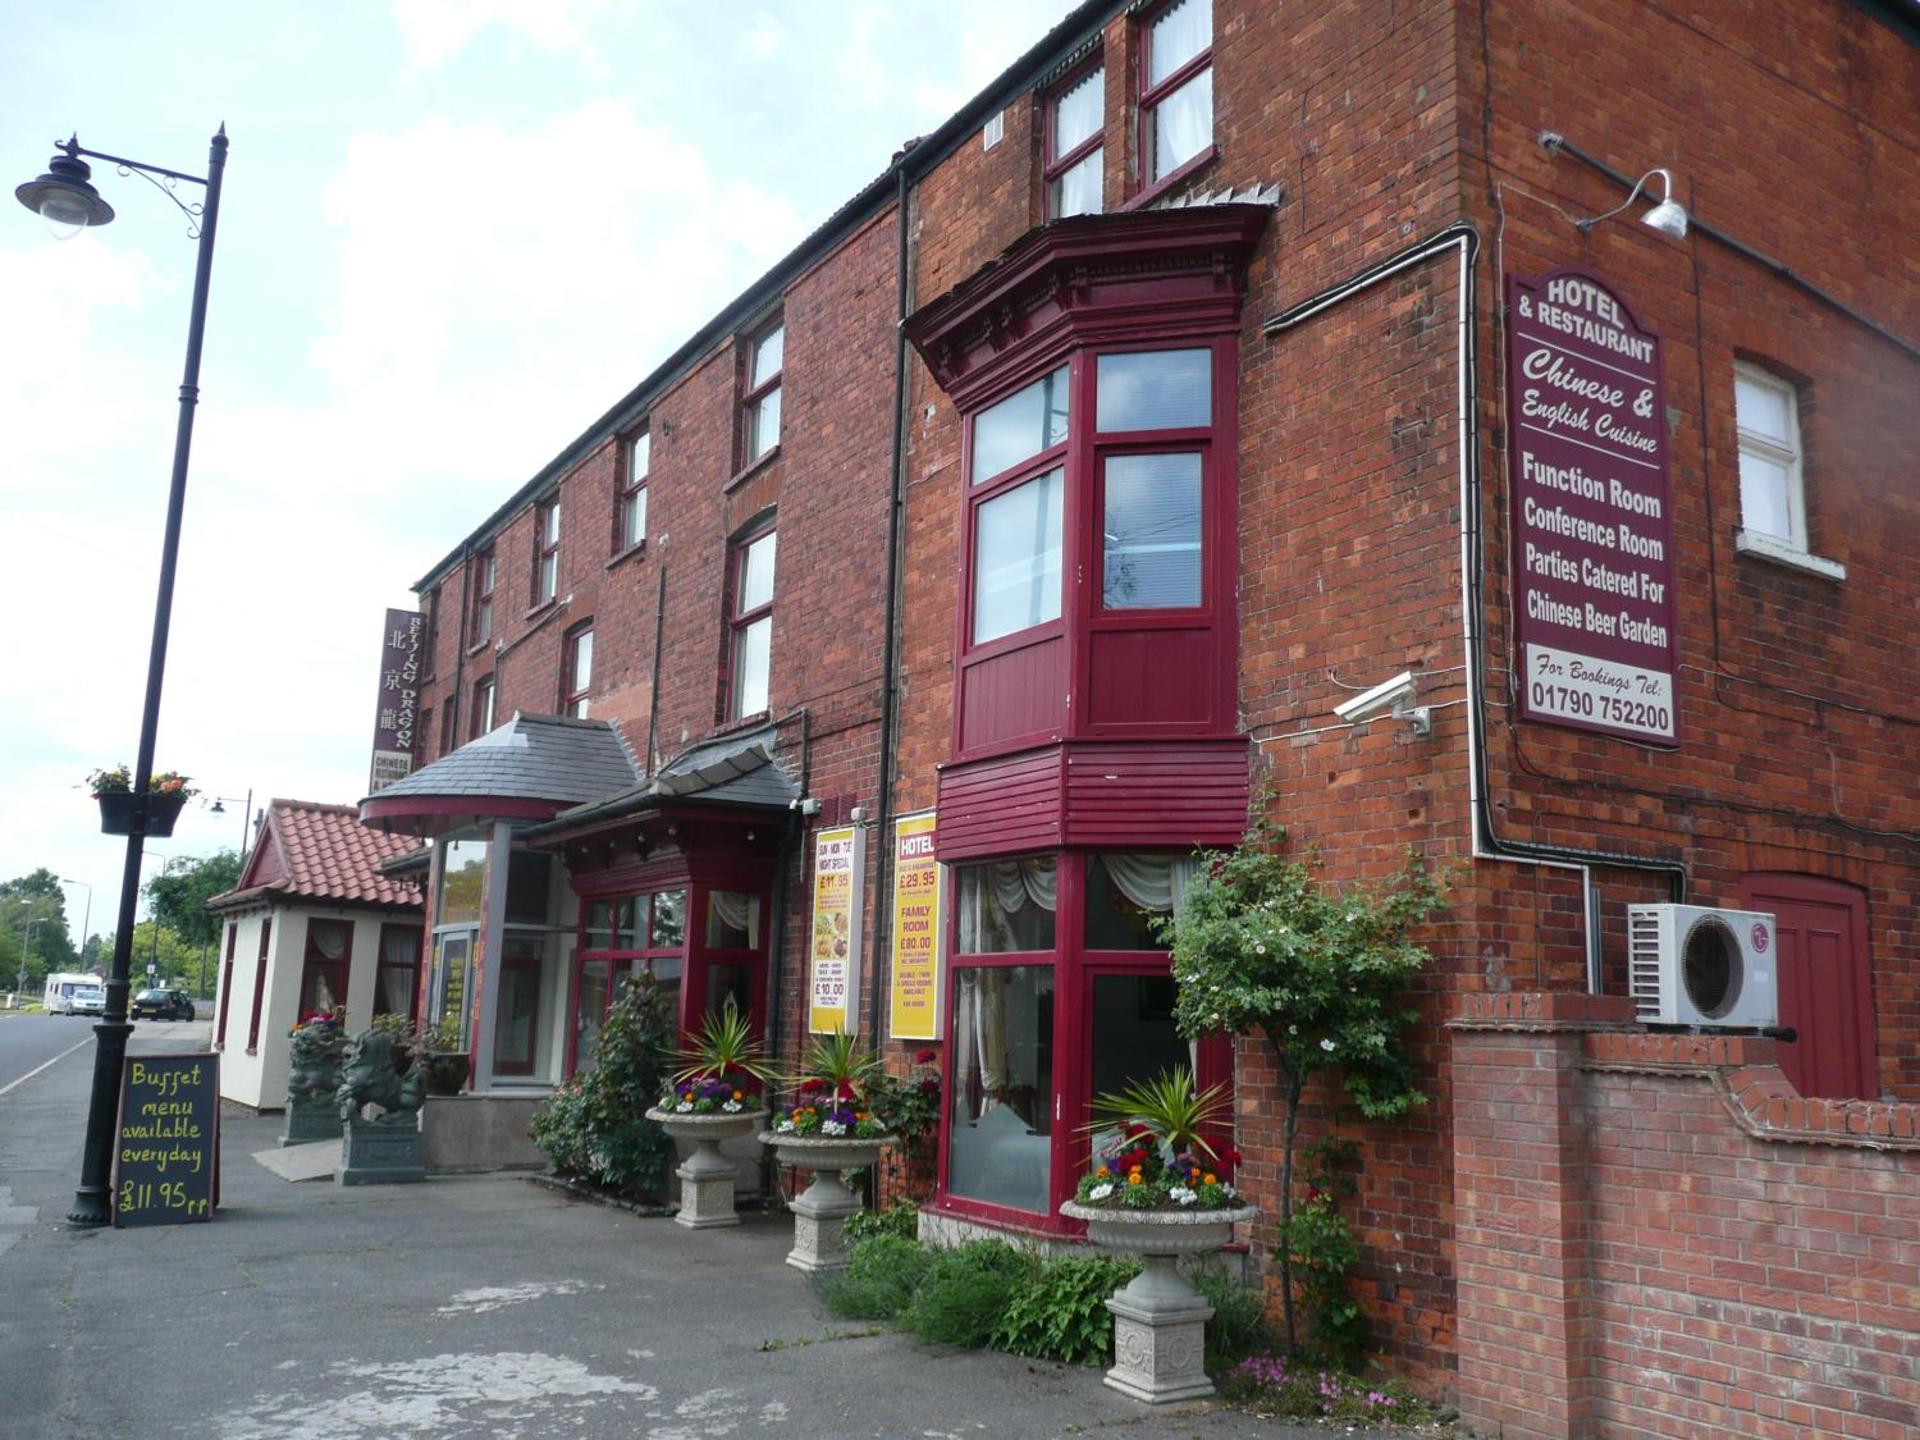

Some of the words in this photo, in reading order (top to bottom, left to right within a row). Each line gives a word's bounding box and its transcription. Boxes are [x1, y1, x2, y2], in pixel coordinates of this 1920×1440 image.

[1548, 279, 1625, 329] HOTEL
[1518, 295, 1533, 318] &
[1538, 301, 1653, 363] RESTAURANT
[1522, 349, 1625, 407] Chinese
[1632, 389, 1654, 419] &
[1522, 388, 1590, 431] English
[1595, 413, 1657, 453] Cuisine
[1522, 451, 1605, 503] Function
[1610, 478, 1662, 518] Room
[1524, 497, 1616, 549] Conference
[1619, 525, 1664, 561] Room
[1526, 542, 1579, 584] Parties
[1582, 557, 1638, 599] Catered
[1641, 573, 1665, 604] For
[1527, 588, 1583, 629] Chinese
[1585, 603, 1617, 637] Beer
[1619, 611, 1667, 648] Garden
[1536, 654, 1564, 676] For
[1569, 661, 1631, 694] Bookings
[1532, 682, 1593, 716] 01790
[1600, 695, 1669, 731] 752200
[901, 835, 935, 856] HOTEL
[900, 870, 935, 888] £29.95
[901, 905, 931, 917] FAMILY
[904, 920, 929, 932] ROOM
[815, 983, 844, 994] £10.00
[132, 1063, 202, 1096] Buffet
[122, 1117, 202, 1138] available
[142, 1101, 193, 1115] menu
[121, 1143, 202, 1172] everyday
